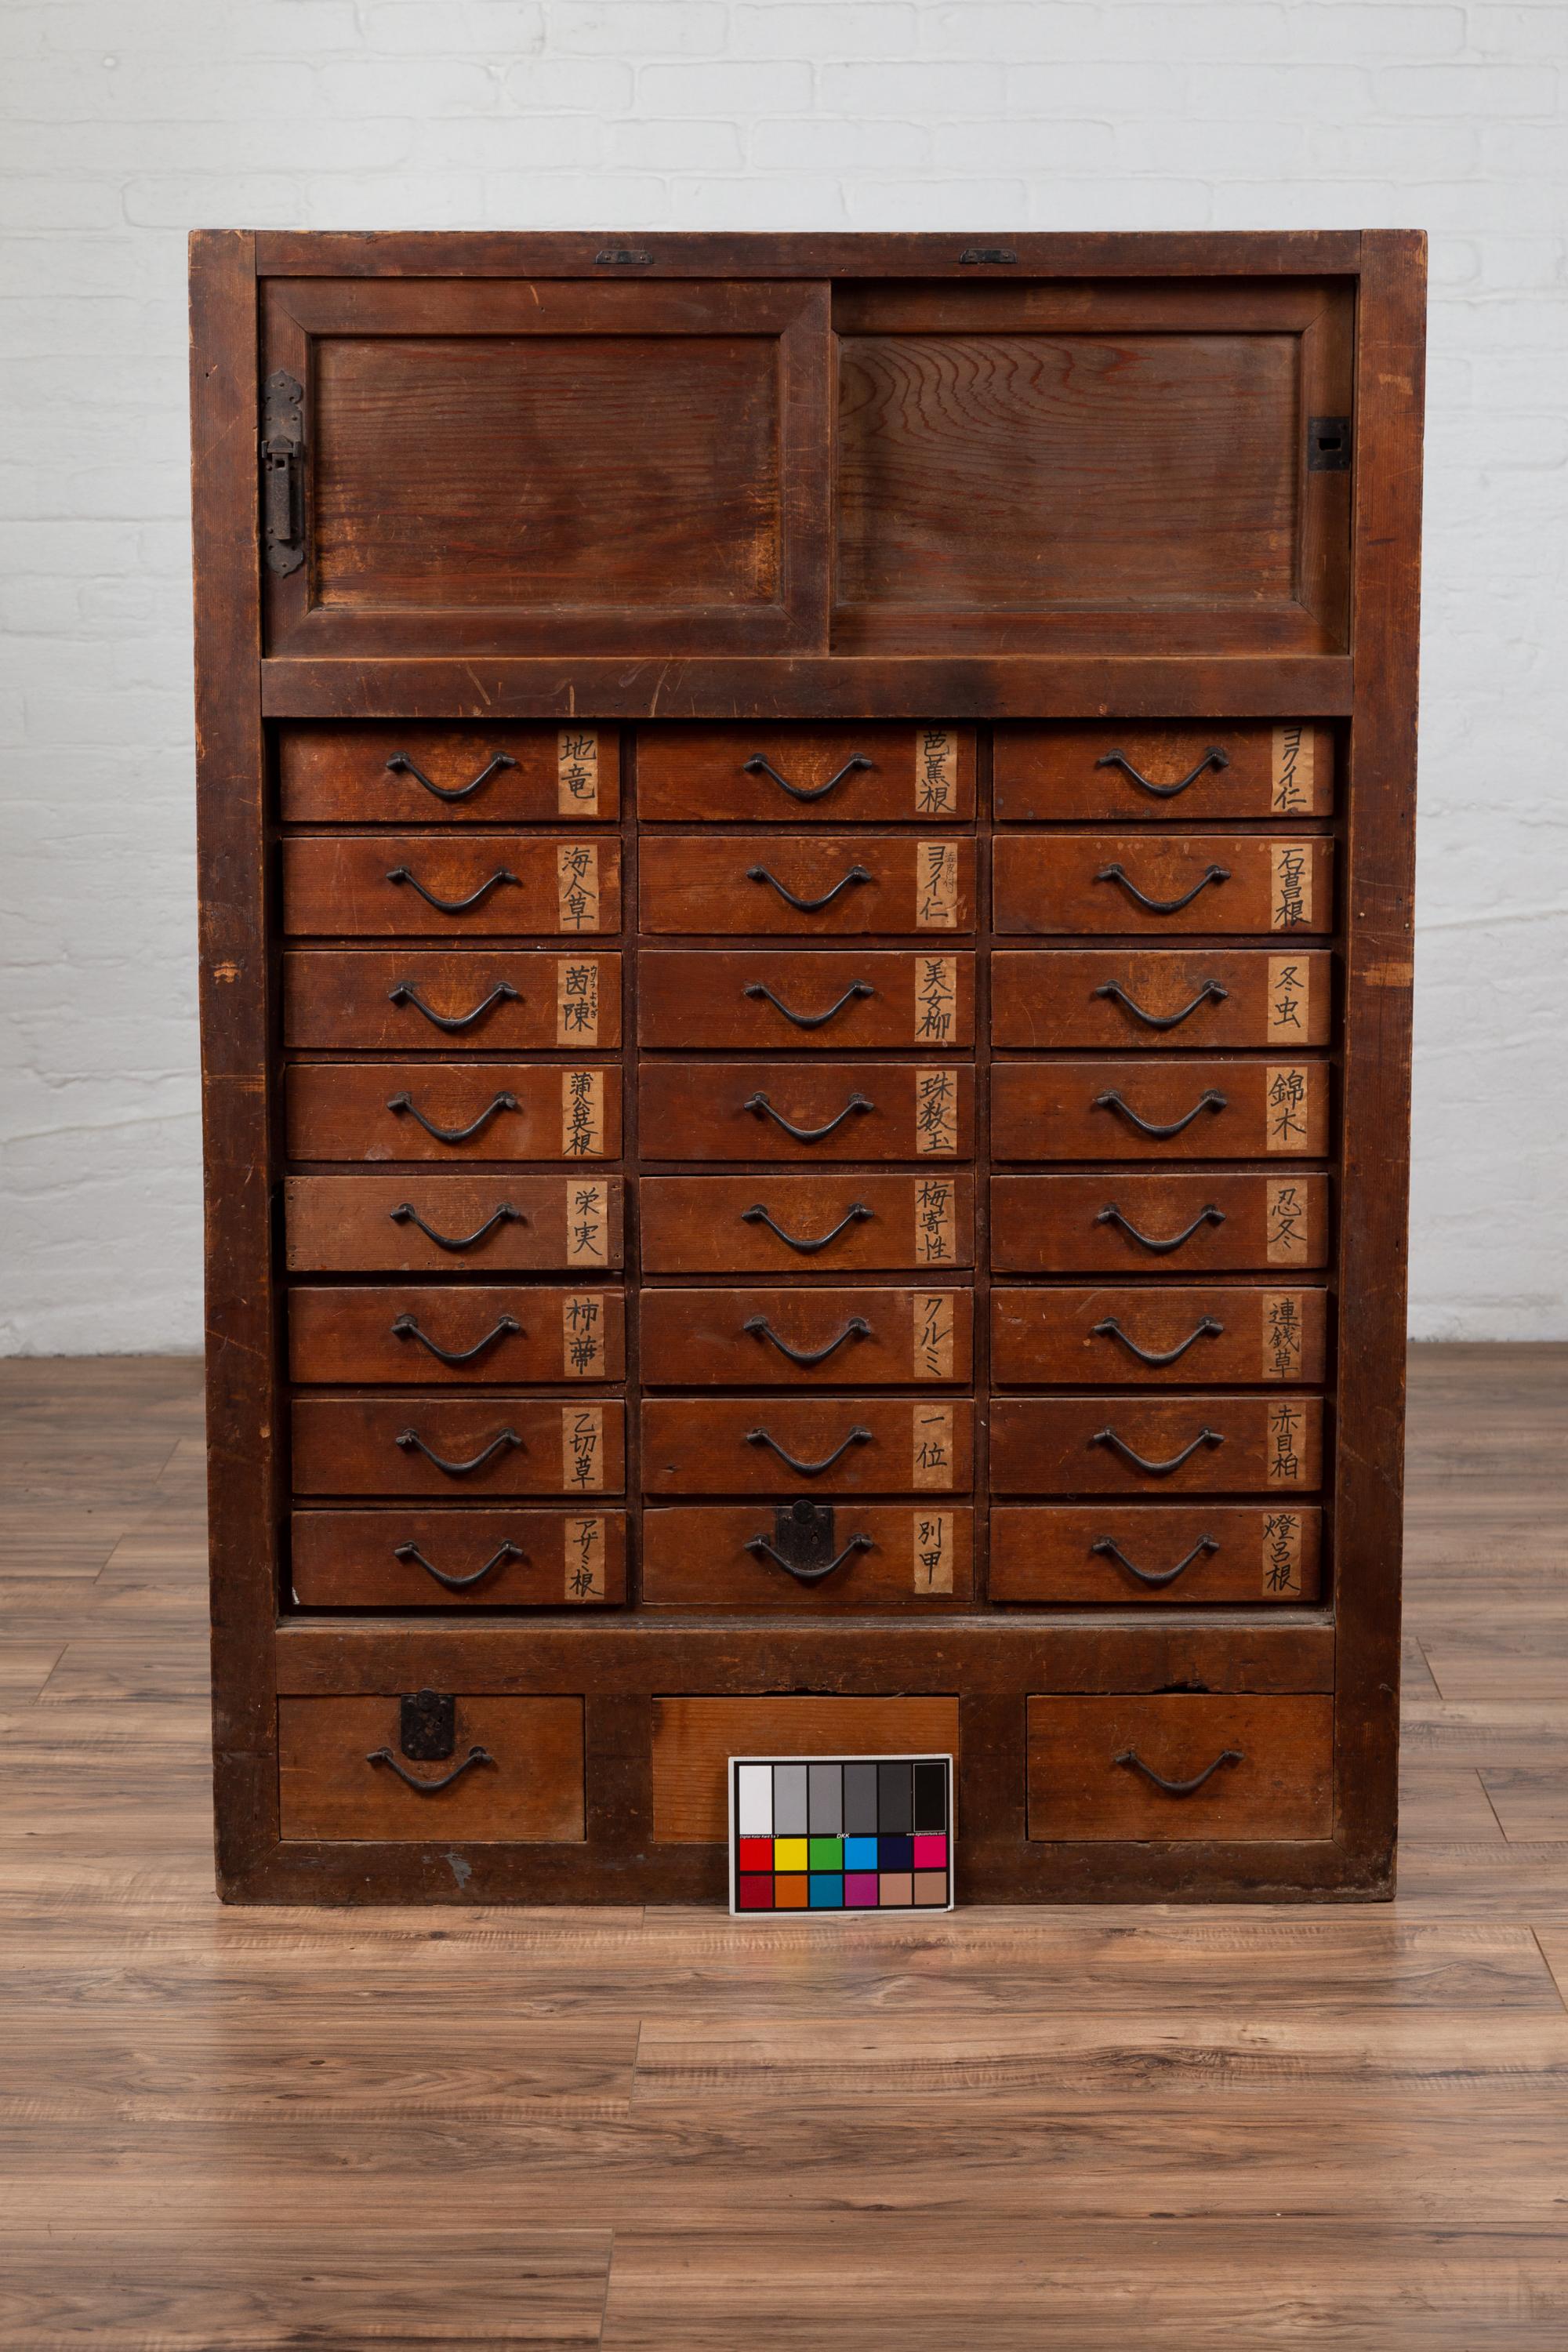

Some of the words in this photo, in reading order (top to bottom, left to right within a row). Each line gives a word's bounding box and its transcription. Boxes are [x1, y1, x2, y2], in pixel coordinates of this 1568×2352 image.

[559, 734, 597, 799] 地竜
[917, 730, 956, 812] 芭蕉根
[1273, 727, 1307, 810] ヨクイ仁
[561, 847, 597, 930] 海人草
[920, 845, 949, 920] ヨクイ仁
[1274, 848, 1312, 927] 石菖根
[563, 964, 594, 1033] 茵陳
[916, 958, 953, 1039] 美女柳
[1273, 965, 1305, 1029] 冬虫
[563, 1071, 604, 1156] 蒲公英根
[917, 1070, 958, 1152] 珠数玉
[1267, 1069, 1307, 1142] 錦木
[572, 1186, 603, 1256] 栄実
[1268, 1188, 1307, 1249] 忍冬
[920, 1298, 950, 1377] クルミ
[569, 1412, 597, 1489] 乙切草
[916, 1415, 948, 1469] 一位
[1270, 1405, 1302, 1479] 赤目柏
[568, 1519, 604, 1599] アザミ根
[917, 1517, 942, 1585] 別甲
[1262, 1514, 1301, 1592] 燈呂根
